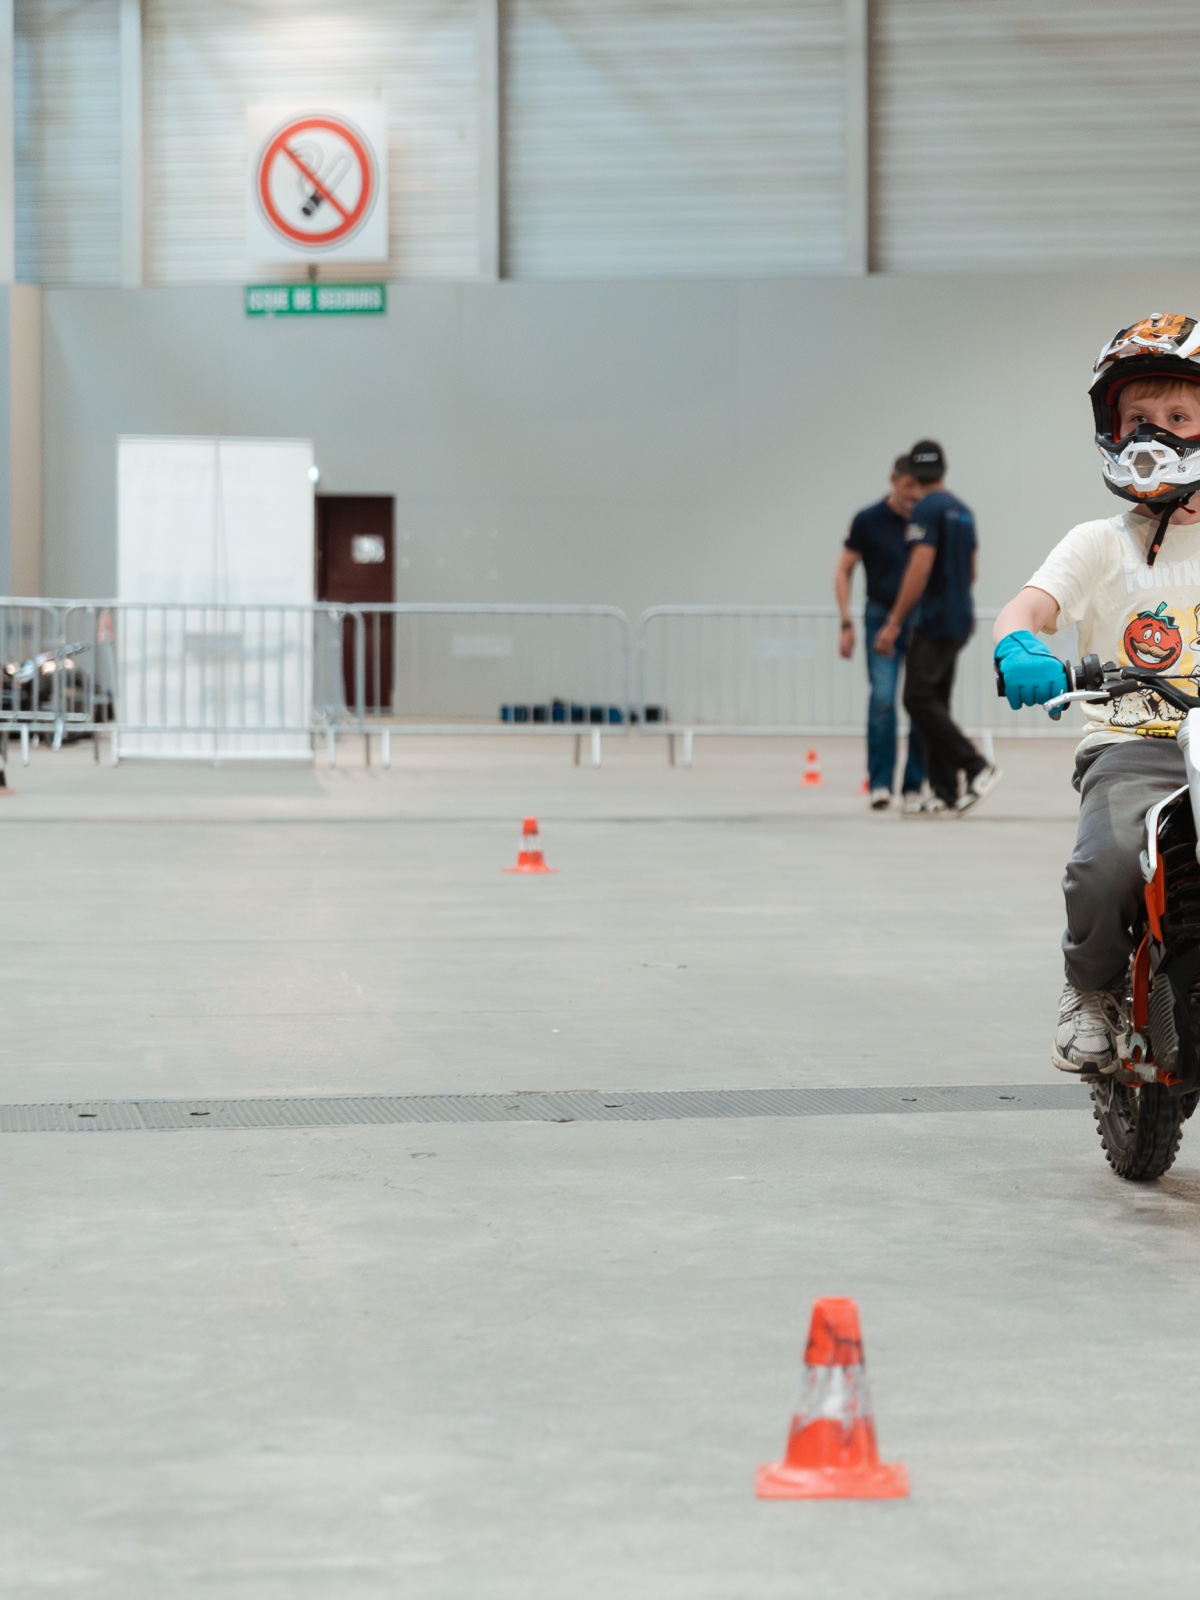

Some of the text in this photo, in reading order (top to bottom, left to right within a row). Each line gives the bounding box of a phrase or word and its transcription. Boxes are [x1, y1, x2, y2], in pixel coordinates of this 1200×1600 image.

[248, 286, 381, 311] ISSUE DE SECOURS
